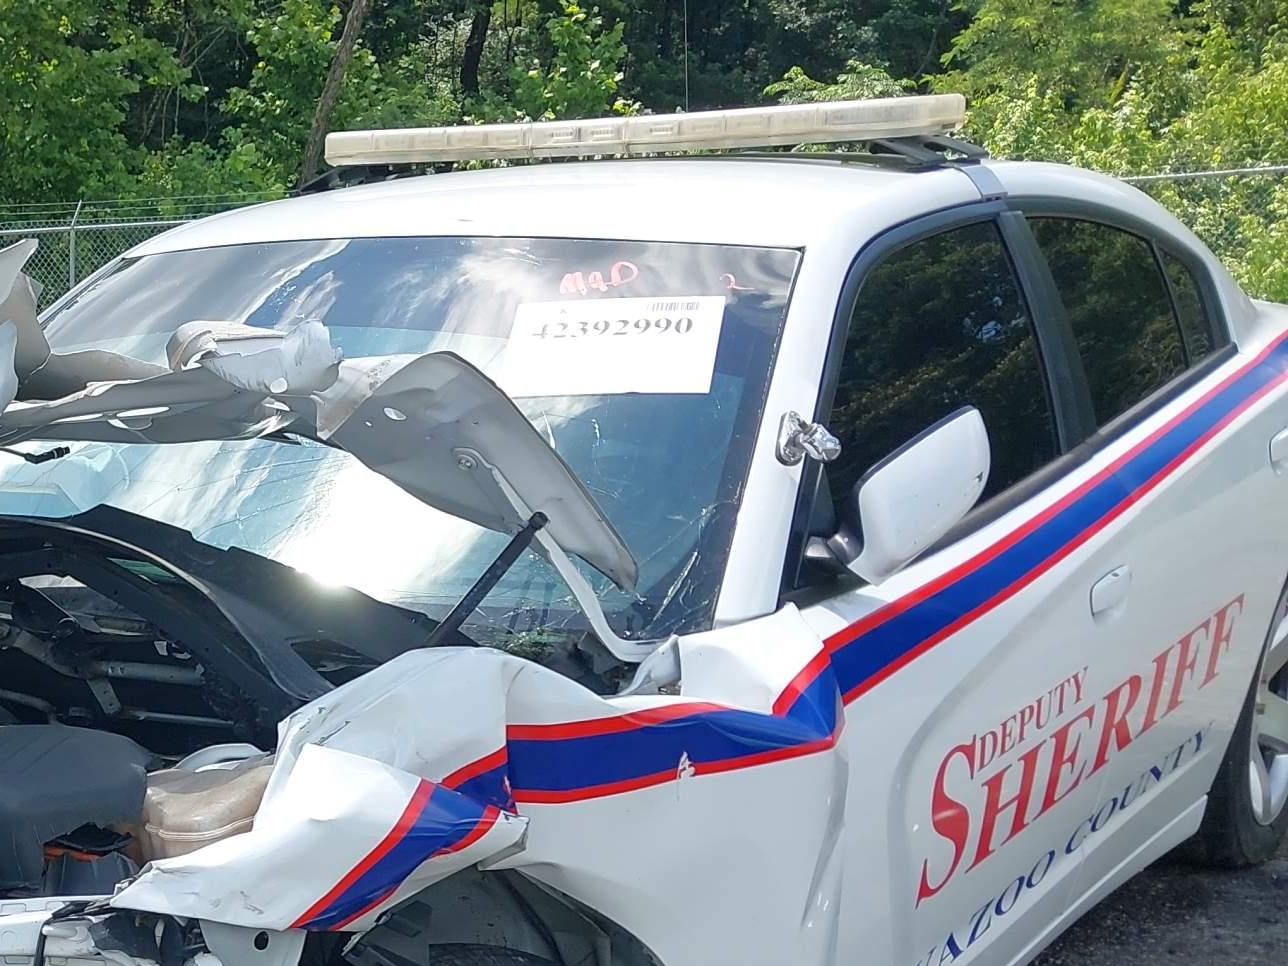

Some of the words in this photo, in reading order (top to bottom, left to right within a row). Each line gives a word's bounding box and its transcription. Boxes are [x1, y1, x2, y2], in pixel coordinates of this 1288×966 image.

[531, 316, 694, 340] 42392990
[915, 593, 1245, 910] SHERIFF
[977, 666, 1089, 773] DEPUTY
[1065, 720, 1215, 856] COUNTY
